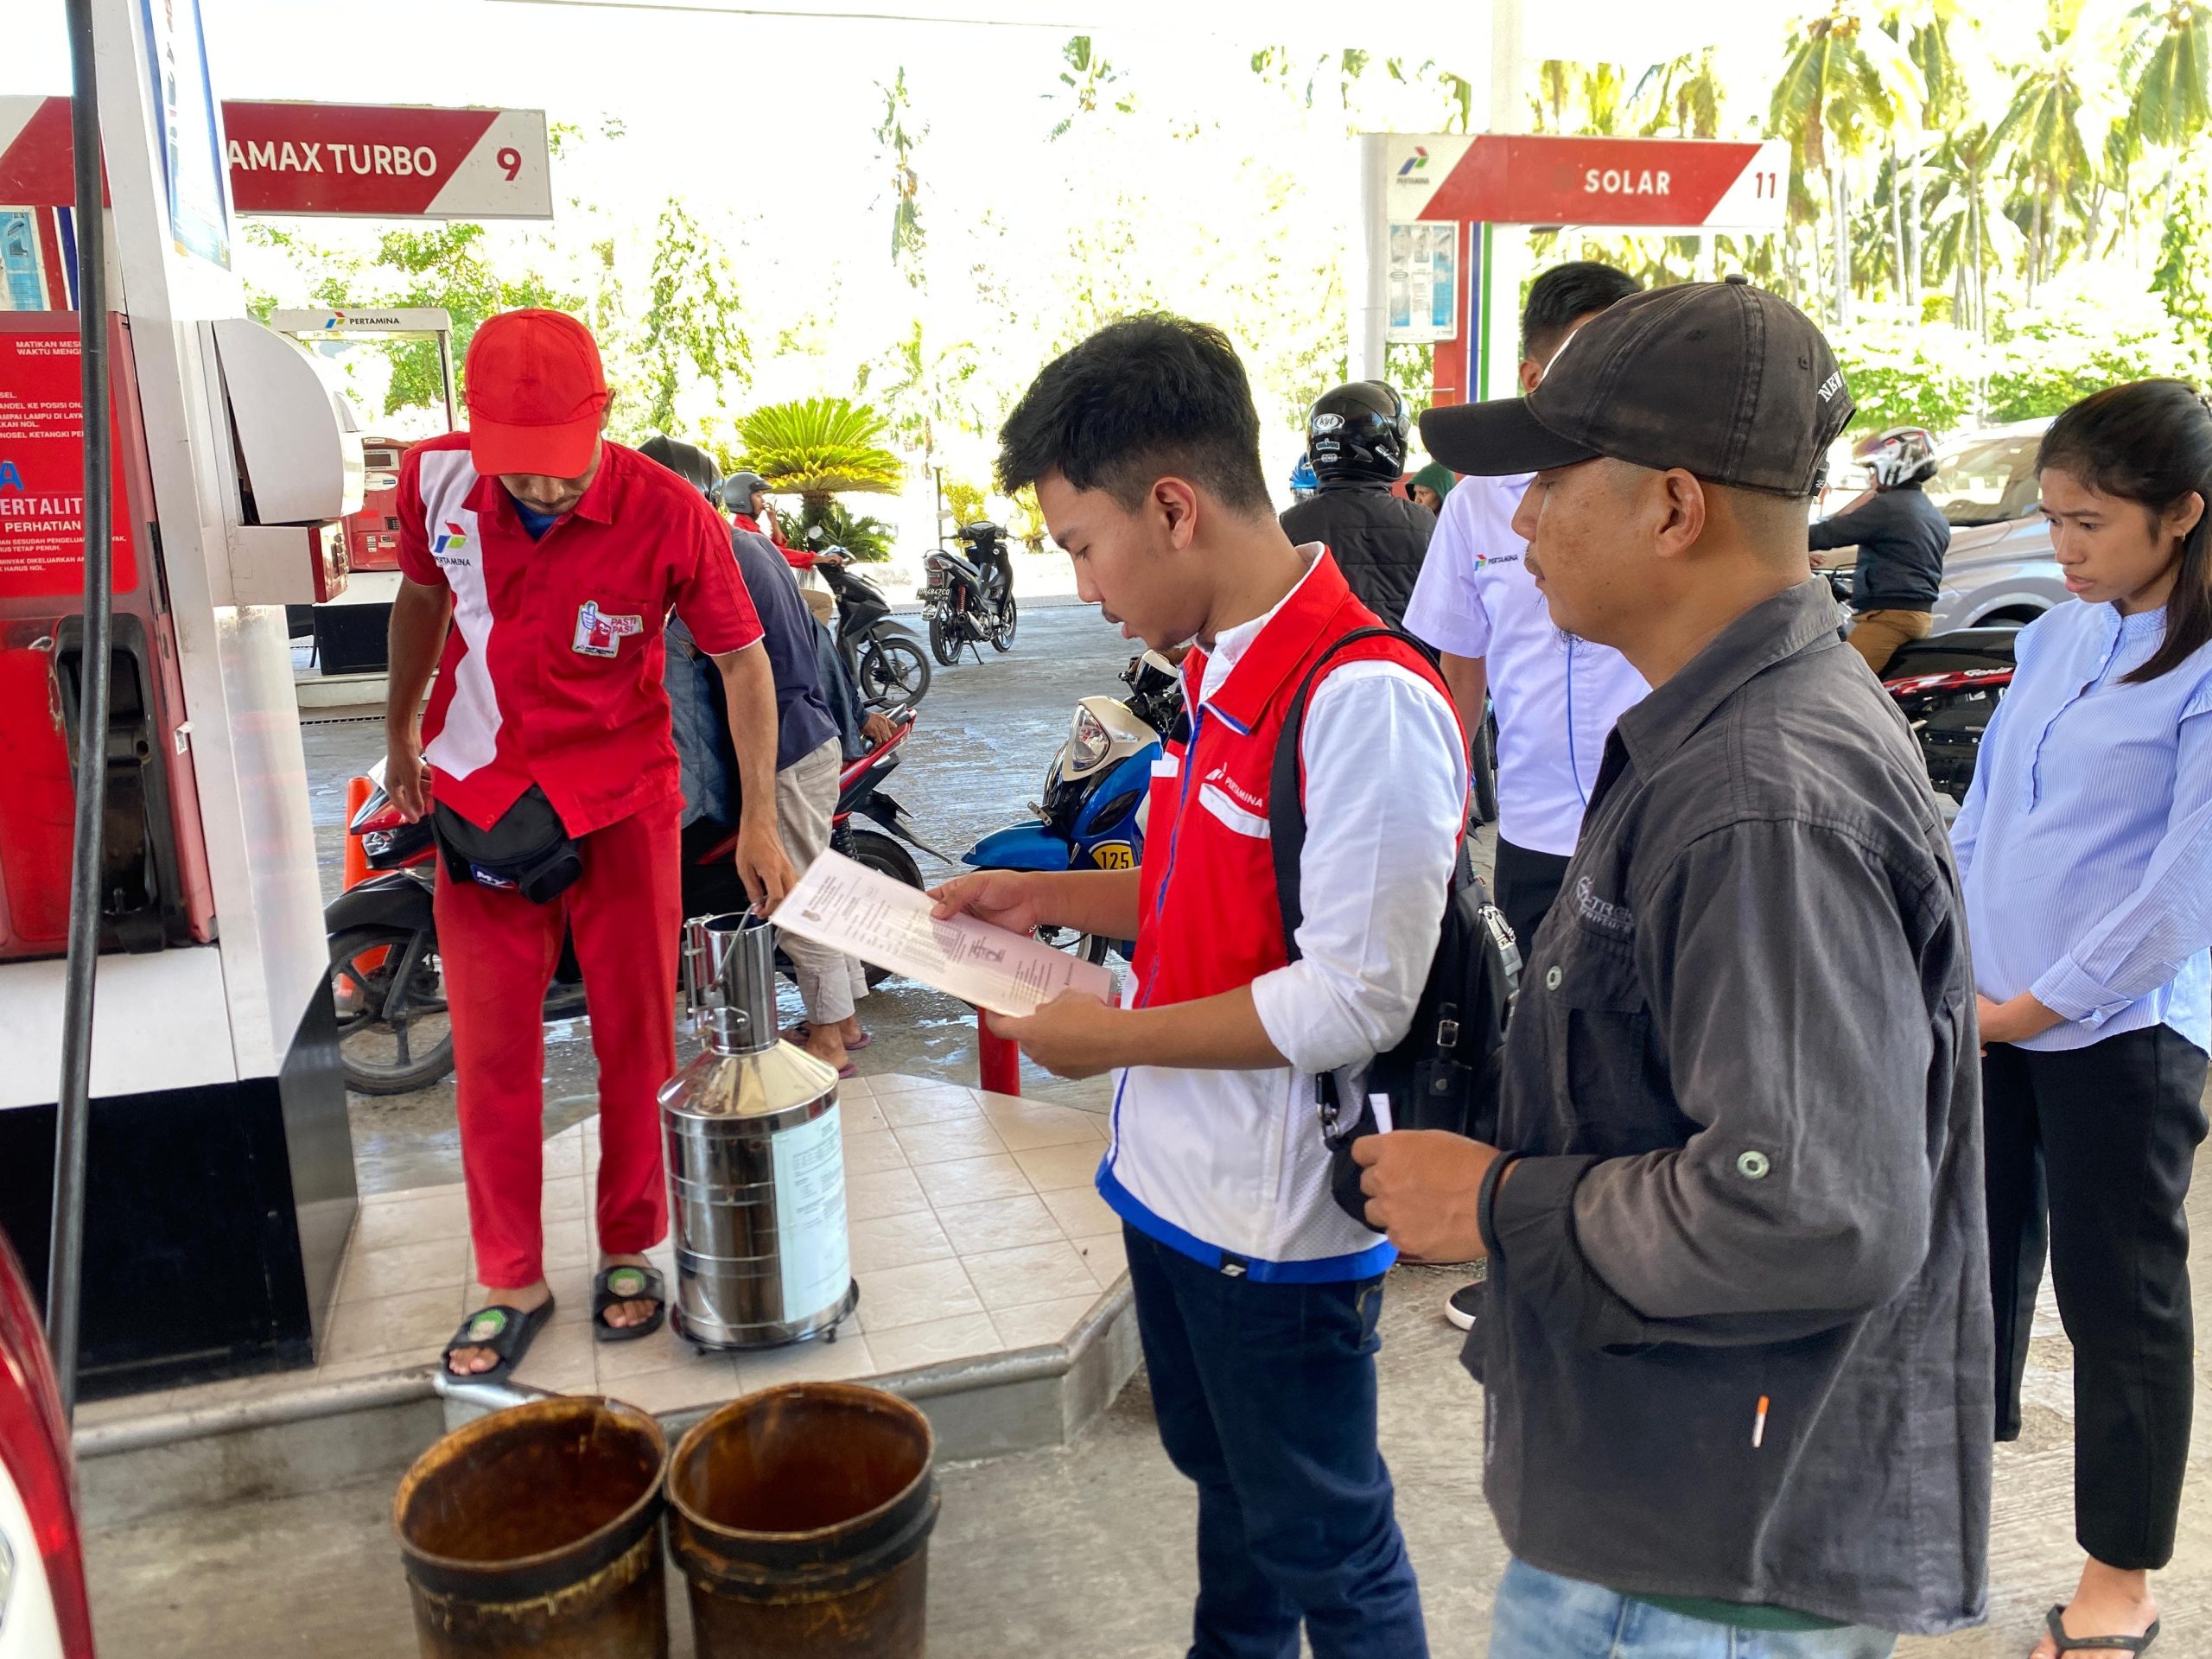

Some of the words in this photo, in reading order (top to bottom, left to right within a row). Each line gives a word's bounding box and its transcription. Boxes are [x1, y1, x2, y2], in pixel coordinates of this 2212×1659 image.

[227, 140, 324, 173] AMAX
[327, 143, 438, 178] TURBO
[496, 147, 522, 181] 9
[1584, 168, 1671, 195] SOLAR
[1755, 171, 1777, 199] 11
[4, 520, 81, 532] PERHATIAN
[611, 618, 637, 627] PASTI
[1224, 776, 1263, 809] PERTAMINA
[1101, 851, 1129, 870] 125
